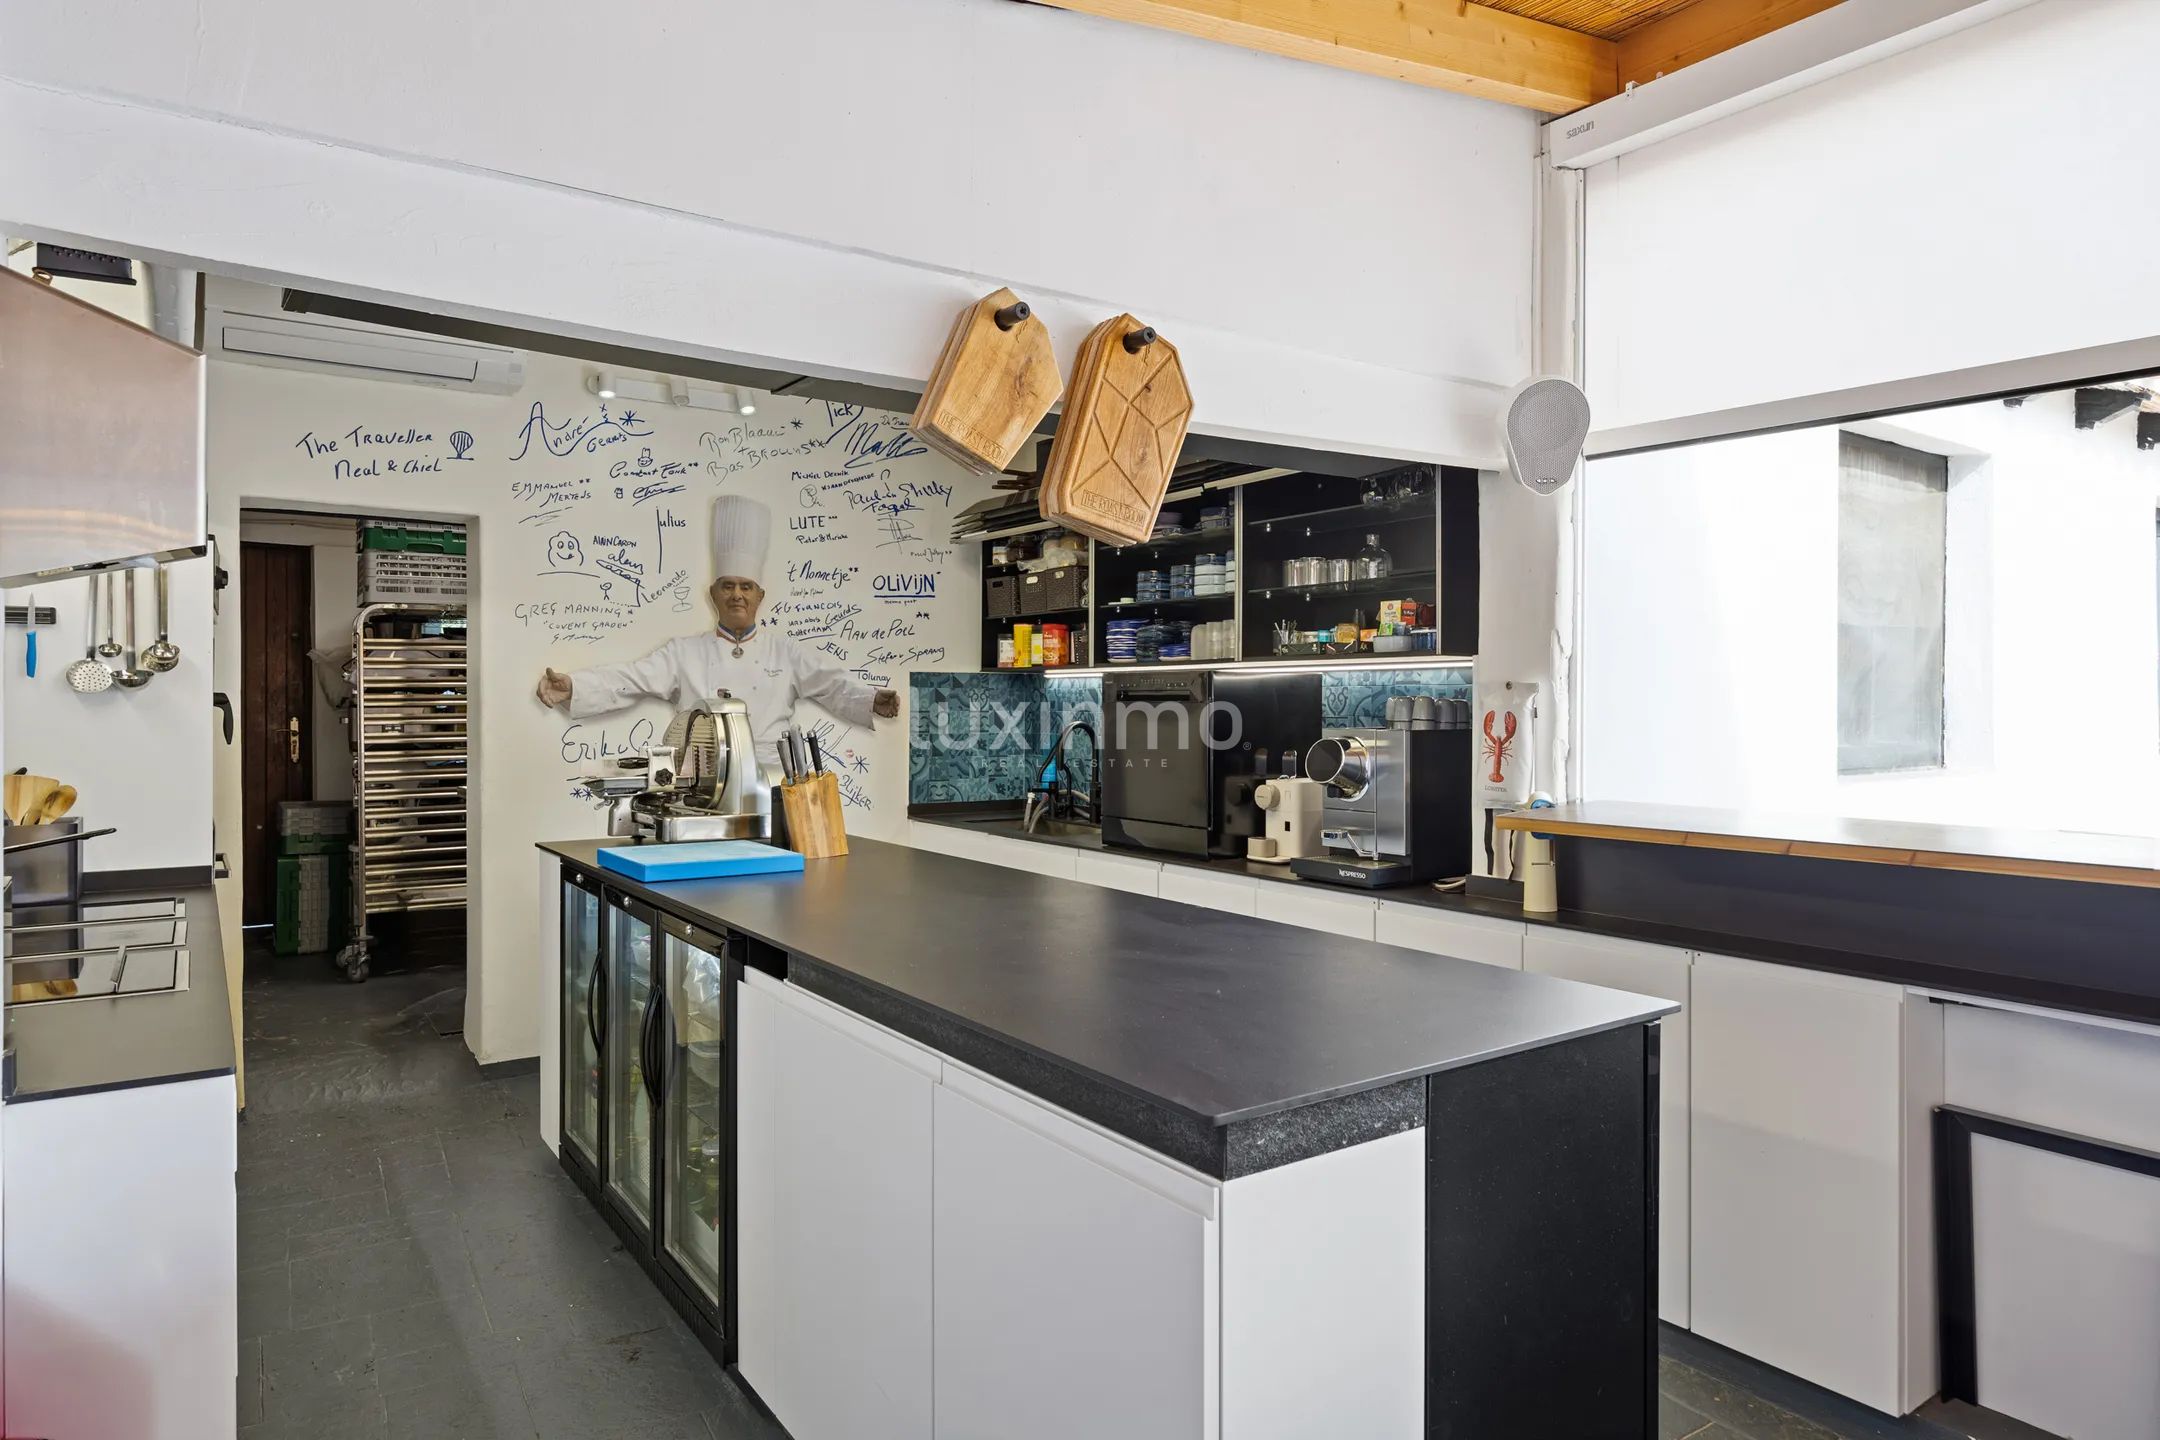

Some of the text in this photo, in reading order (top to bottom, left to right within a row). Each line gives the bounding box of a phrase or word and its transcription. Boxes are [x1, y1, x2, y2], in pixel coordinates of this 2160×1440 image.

[1566, 120, 1595, 139] saxun
[296, 432, 339, 458] The
[335, 459, 381, 480] Neal
[387, 460, 398, 472] &
[789, 515, 826, 530] LUTE
[641, 568, 687, 604] Leonardo
[816, 641, 848, 660] JENS
[561, 724, 615, 763] Erik
[1338, 869, 1366, 879] NESPRESSO
